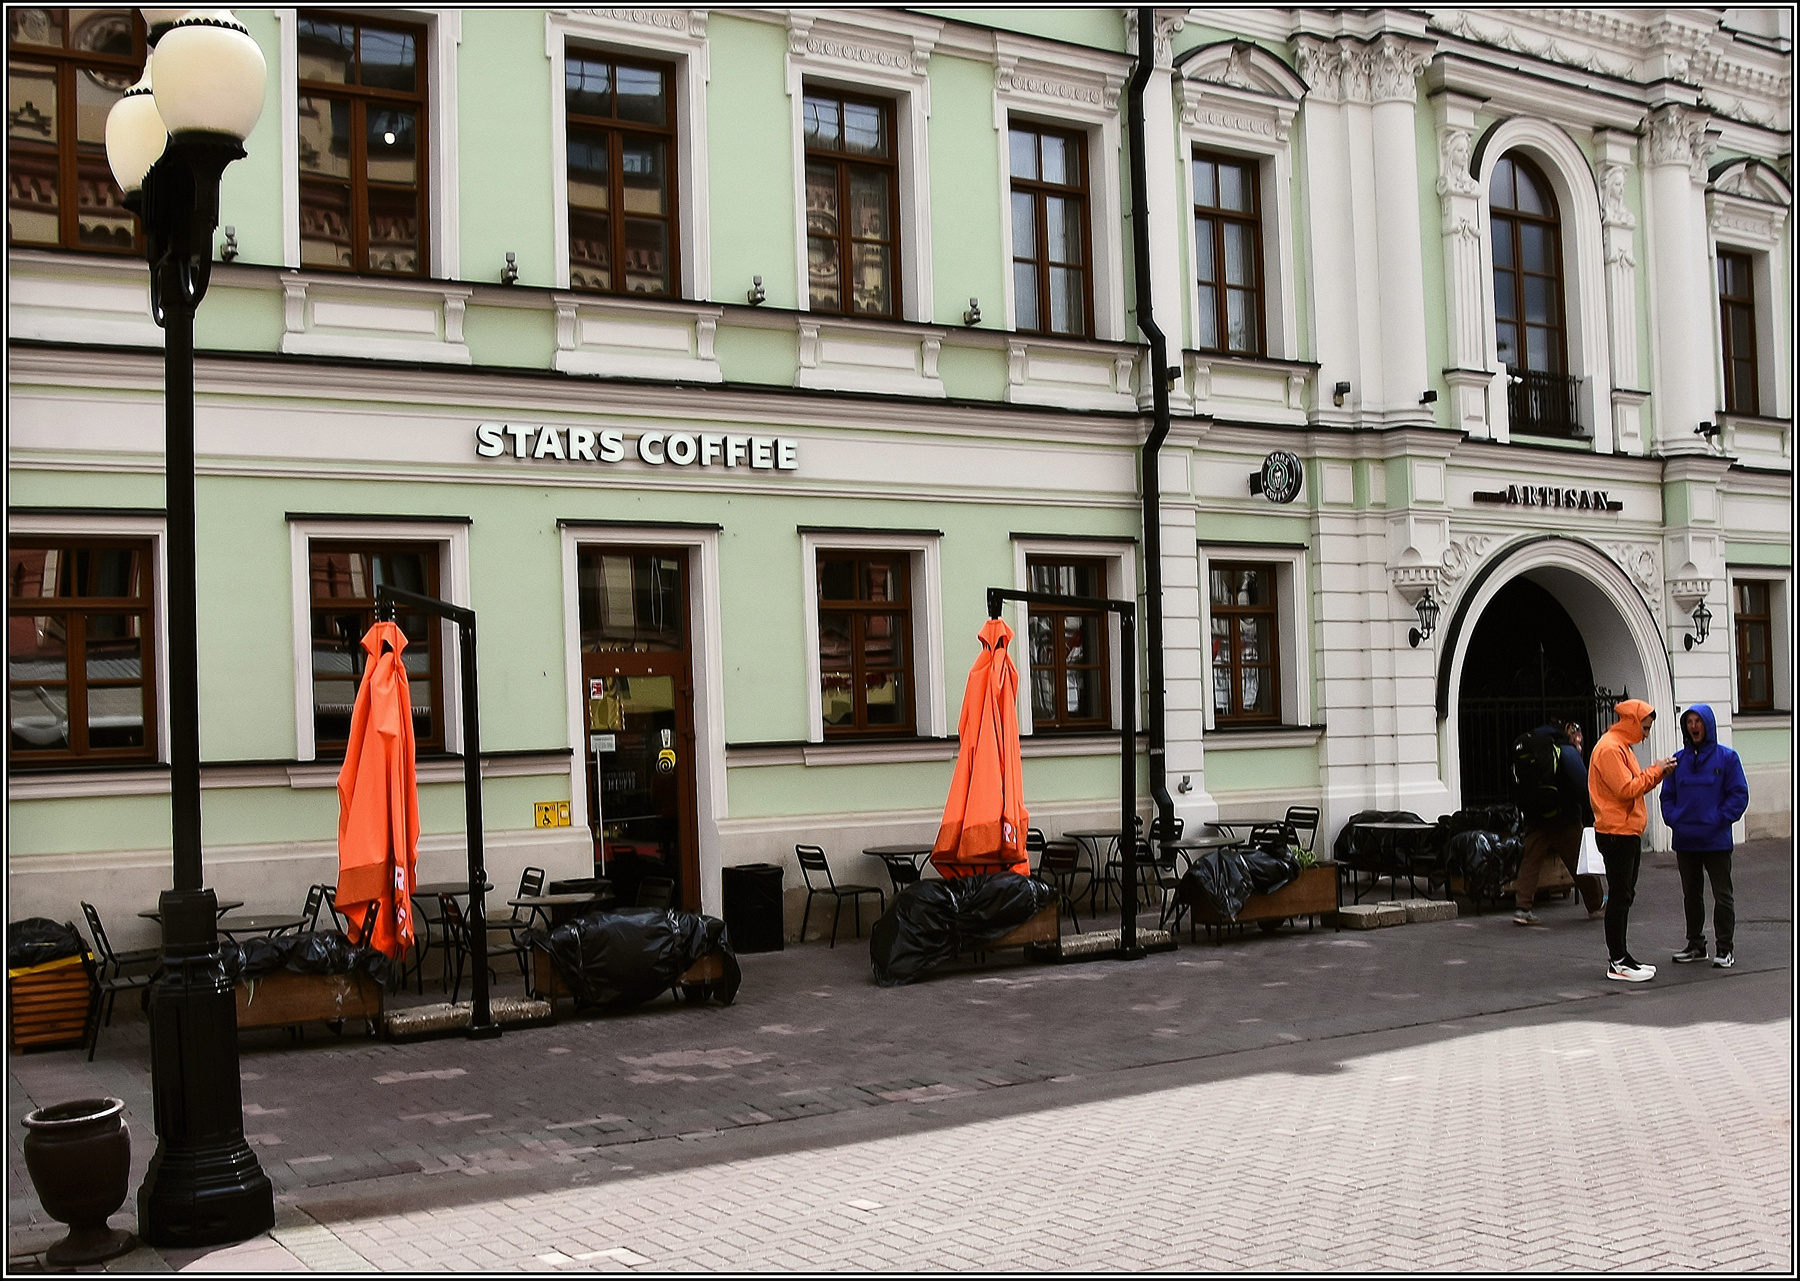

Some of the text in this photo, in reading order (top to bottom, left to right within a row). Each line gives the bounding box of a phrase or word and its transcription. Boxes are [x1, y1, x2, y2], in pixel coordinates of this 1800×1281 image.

[475, 423, 799, 470] STARS COFFEE
[1266, 453, 1290, 467] STARS
[1507, 484, 1609, 512] ARTISAN
